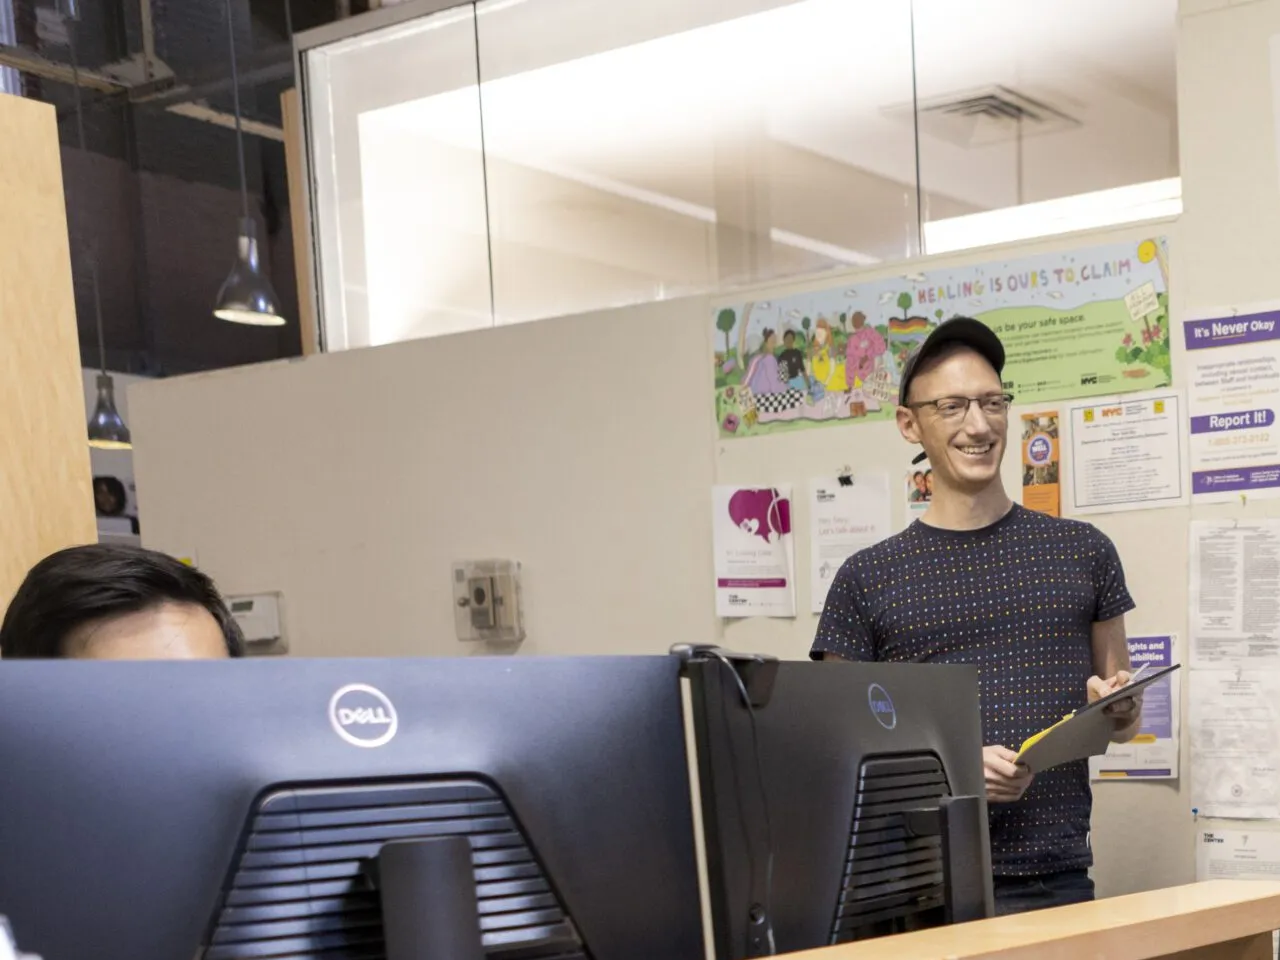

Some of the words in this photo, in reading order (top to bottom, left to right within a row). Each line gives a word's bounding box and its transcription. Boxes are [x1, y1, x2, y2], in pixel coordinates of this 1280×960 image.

[917, 280, 984, 304] HEALING
[990, 276, 1003, 293] IS
[1007, 269, 1049, 292] OURS
[1053, 268, 1076, 285] TO
[1081, 258, 1132, 282] CLAIM
[1004, 322, 1016, 331] be
[1018, 320, 1037, 332] your
[1039, 317, 1057, 327] safe
[1194, 327, 1210, 338] It's
[1212, 321, 1248, 337] Never
[1250, 319, 1275, 331] Okay
[1081, 376, 1097, 385] NYC
[1210, 412, 1250, 429] Report
[1253, 410, 1267, 424] It!
[1128, 641, 1147, 653] ights
[1149, 641, 1165, 650] and
[338, 706, 392, 725] DELL
